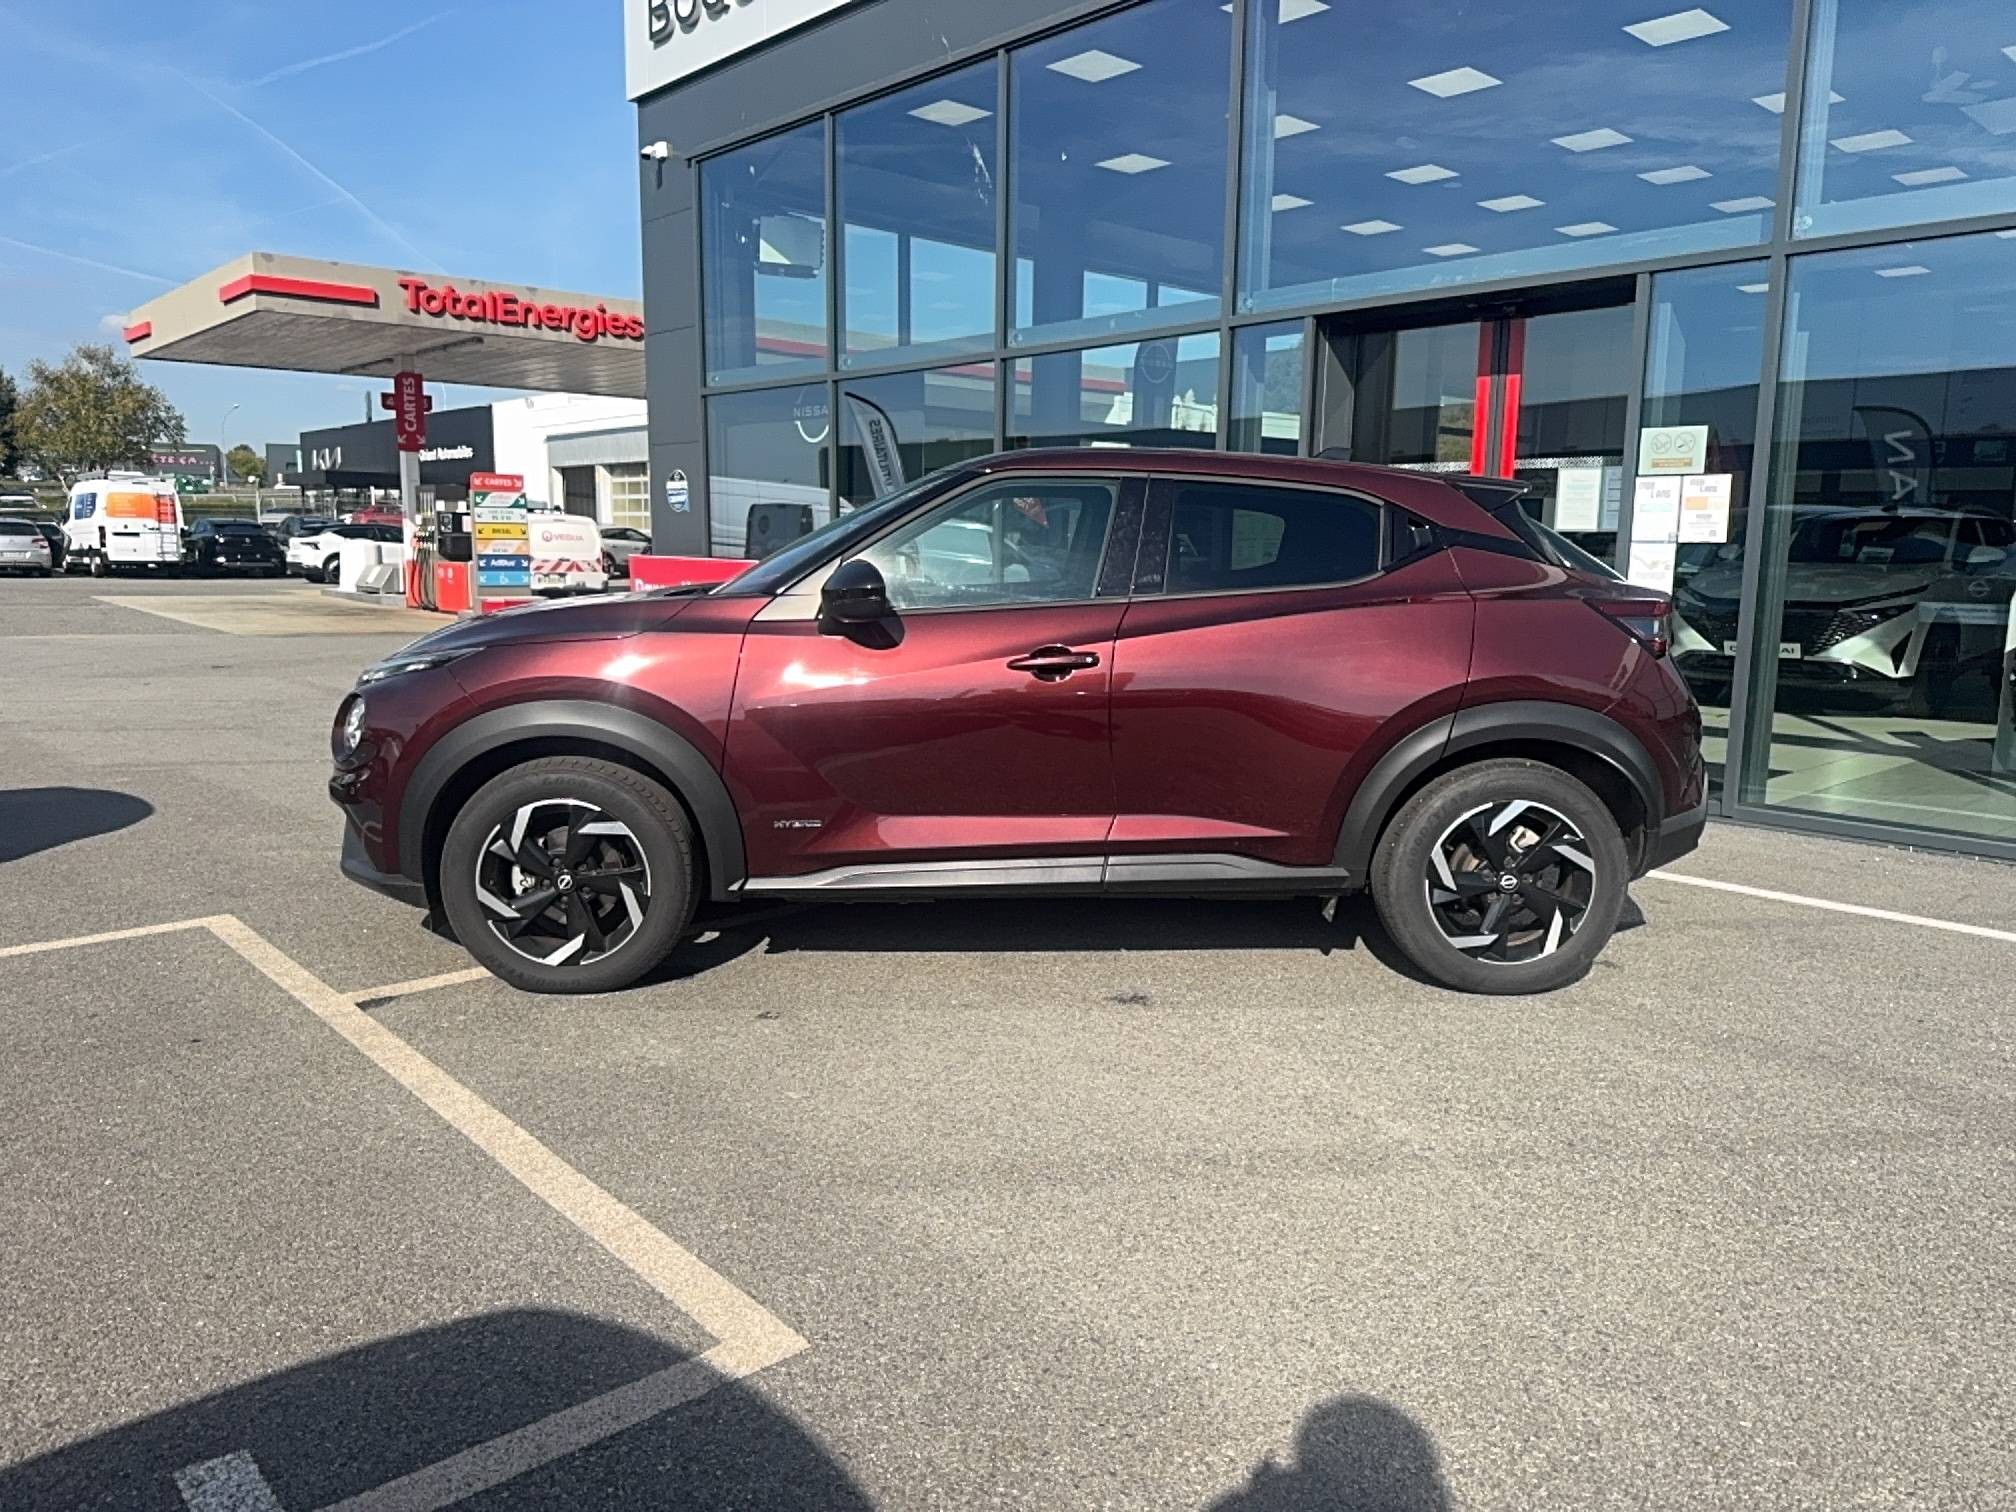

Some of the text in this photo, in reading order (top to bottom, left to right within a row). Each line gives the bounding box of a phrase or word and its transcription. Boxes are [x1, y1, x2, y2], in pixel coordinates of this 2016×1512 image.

[398, 277, 645, 343] TotalEnergies
[402, 377, 417, 432] CARTES
[793, 404, 829, 418] NISSA
[484, 479, 513, 488] CARTES
